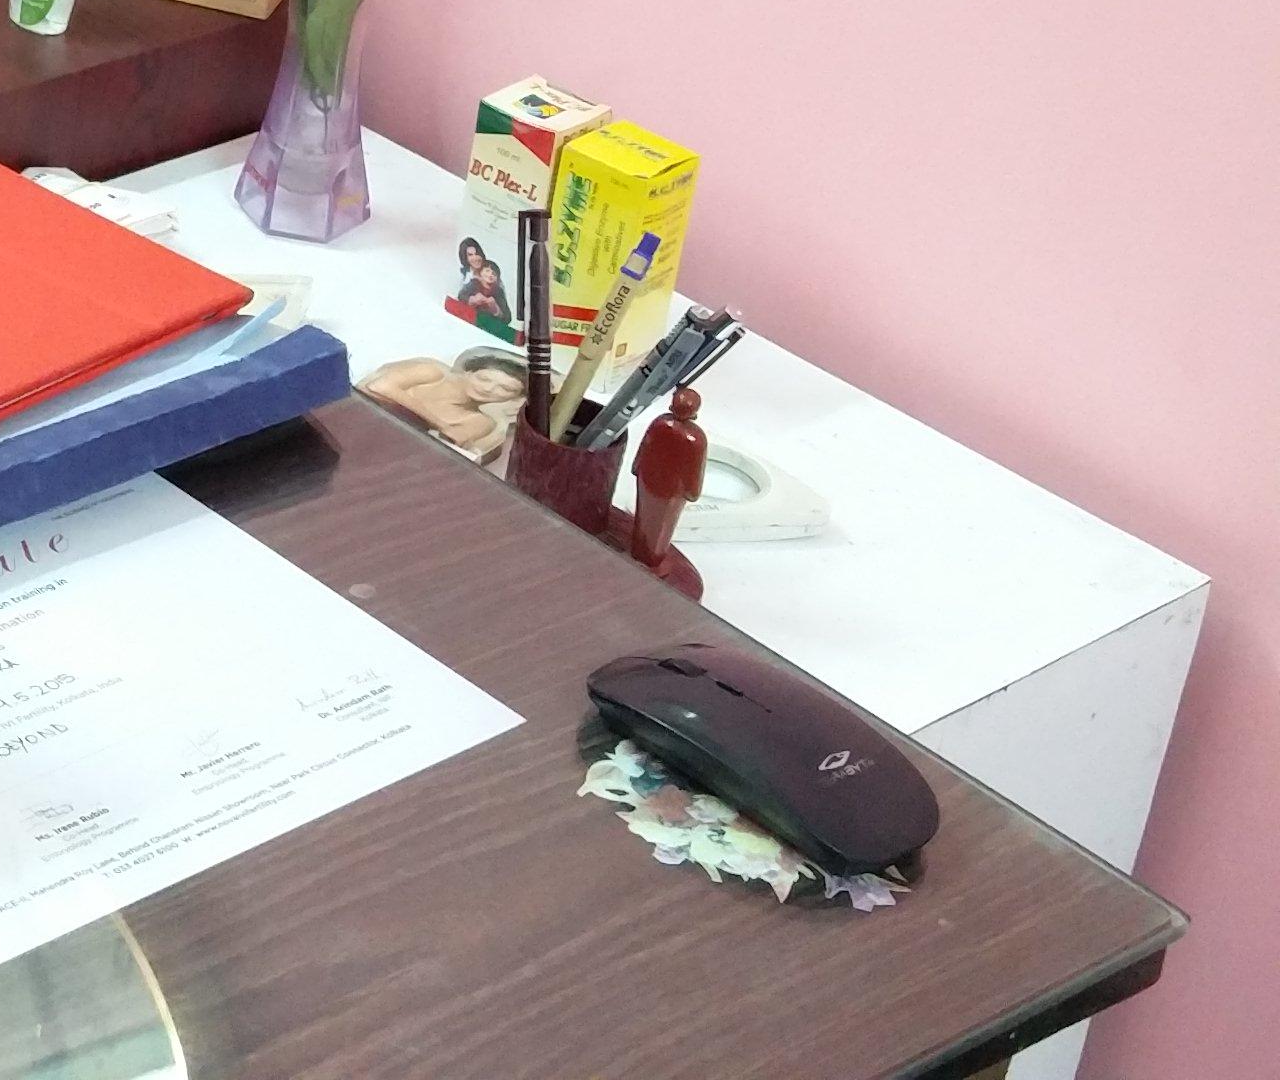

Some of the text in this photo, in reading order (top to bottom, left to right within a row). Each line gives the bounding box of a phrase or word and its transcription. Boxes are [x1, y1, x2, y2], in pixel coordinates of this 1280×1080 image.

[469, 158, 494, 181] BC
[595, 285, 631, 336] Ecoflora
[9, 580, 56, 608] training
[56, 576, 68, 587] in
[52, 820, 80, 835] Irene
[79, 807, 110, 823] Rubio
[117, 841, 150, 860] Behind
[290, 768, 310, 782] Park
